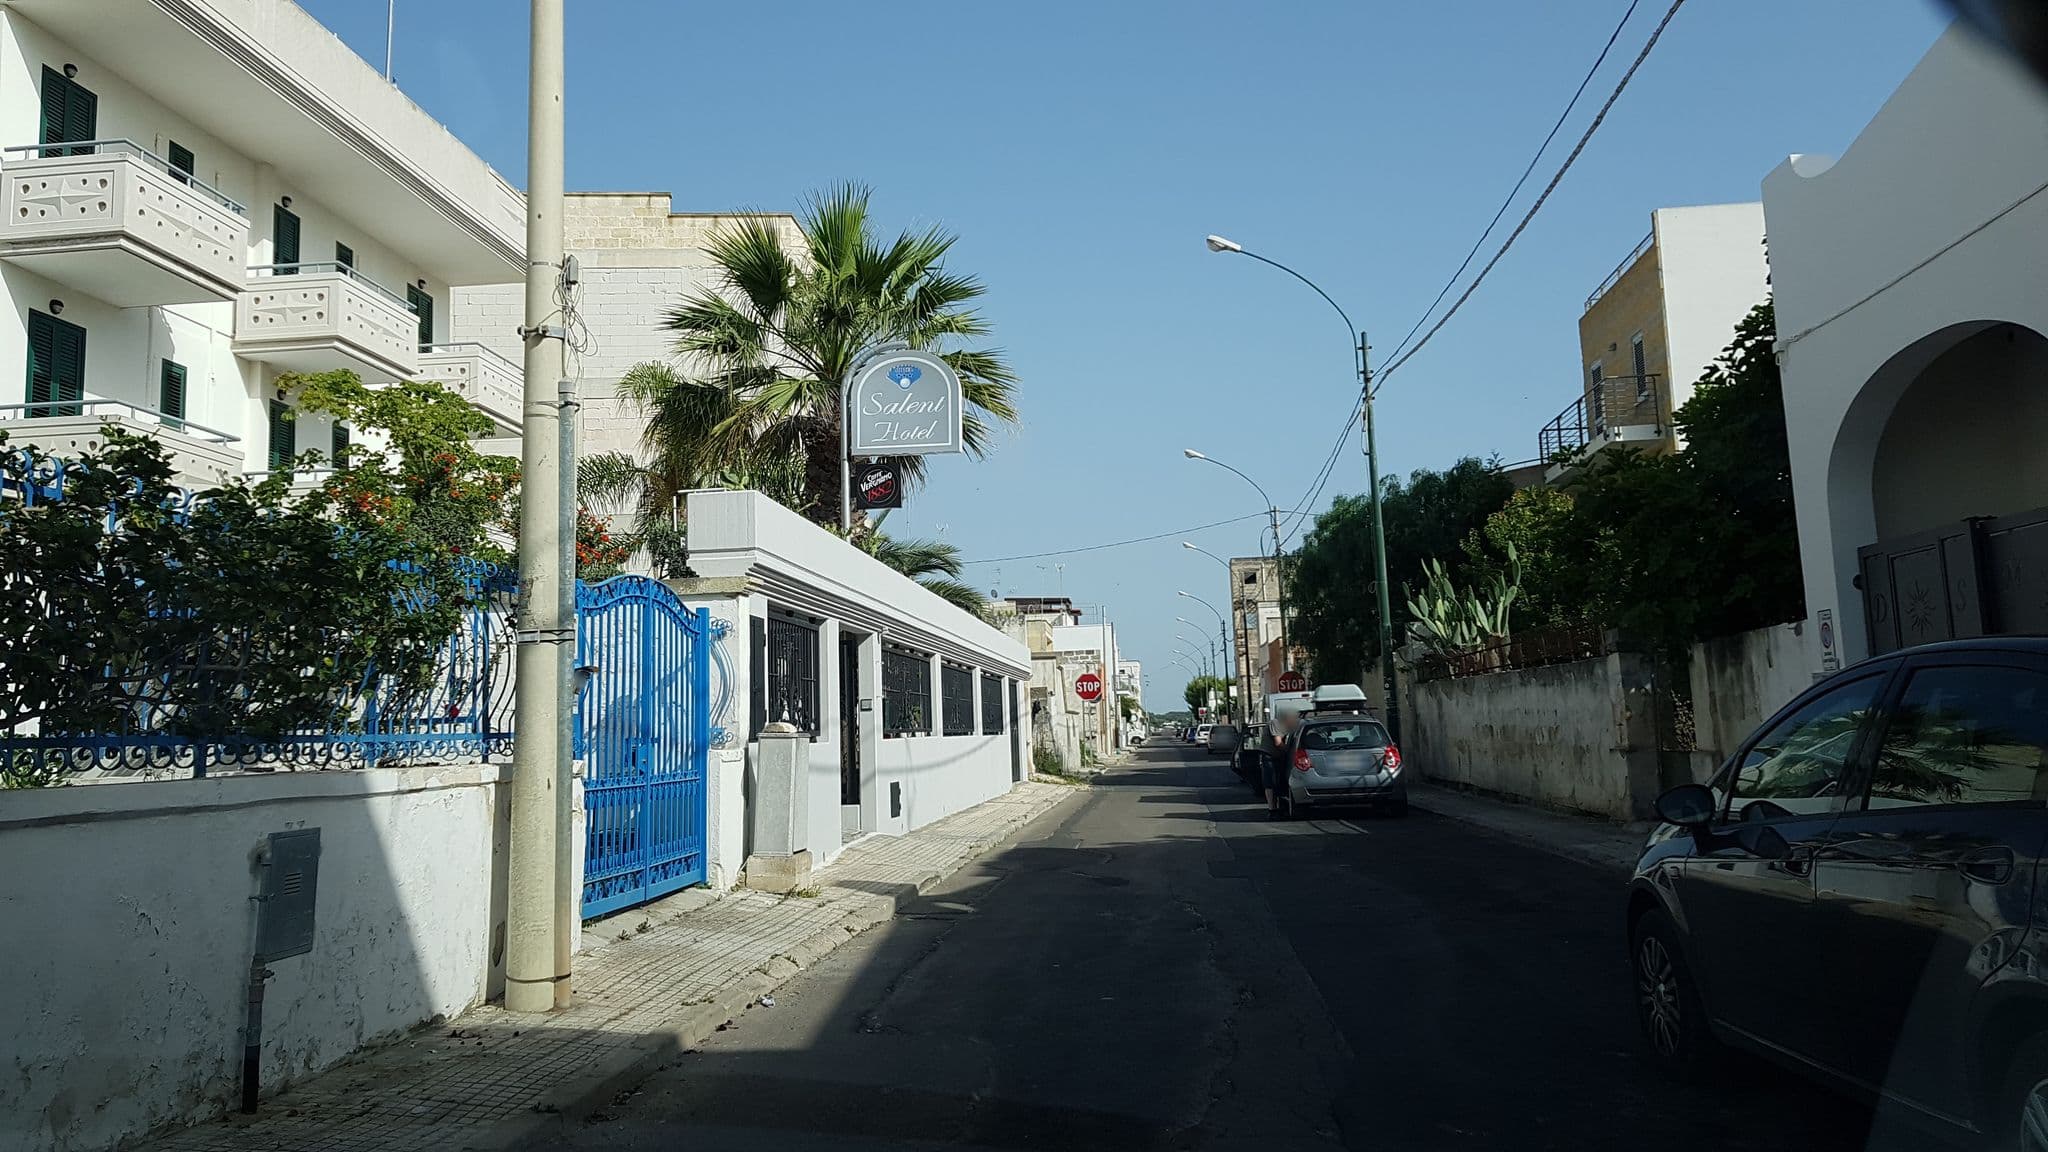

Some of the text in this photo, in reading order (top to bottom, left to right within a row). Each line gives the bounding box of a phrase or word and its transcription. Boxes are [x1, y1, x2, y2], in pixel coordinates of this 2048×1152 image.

[872, 420, 938, 442] Hotel
[1076, 681, 1100, 693] STOP
[1279, 679, 1305, 690] STOP
